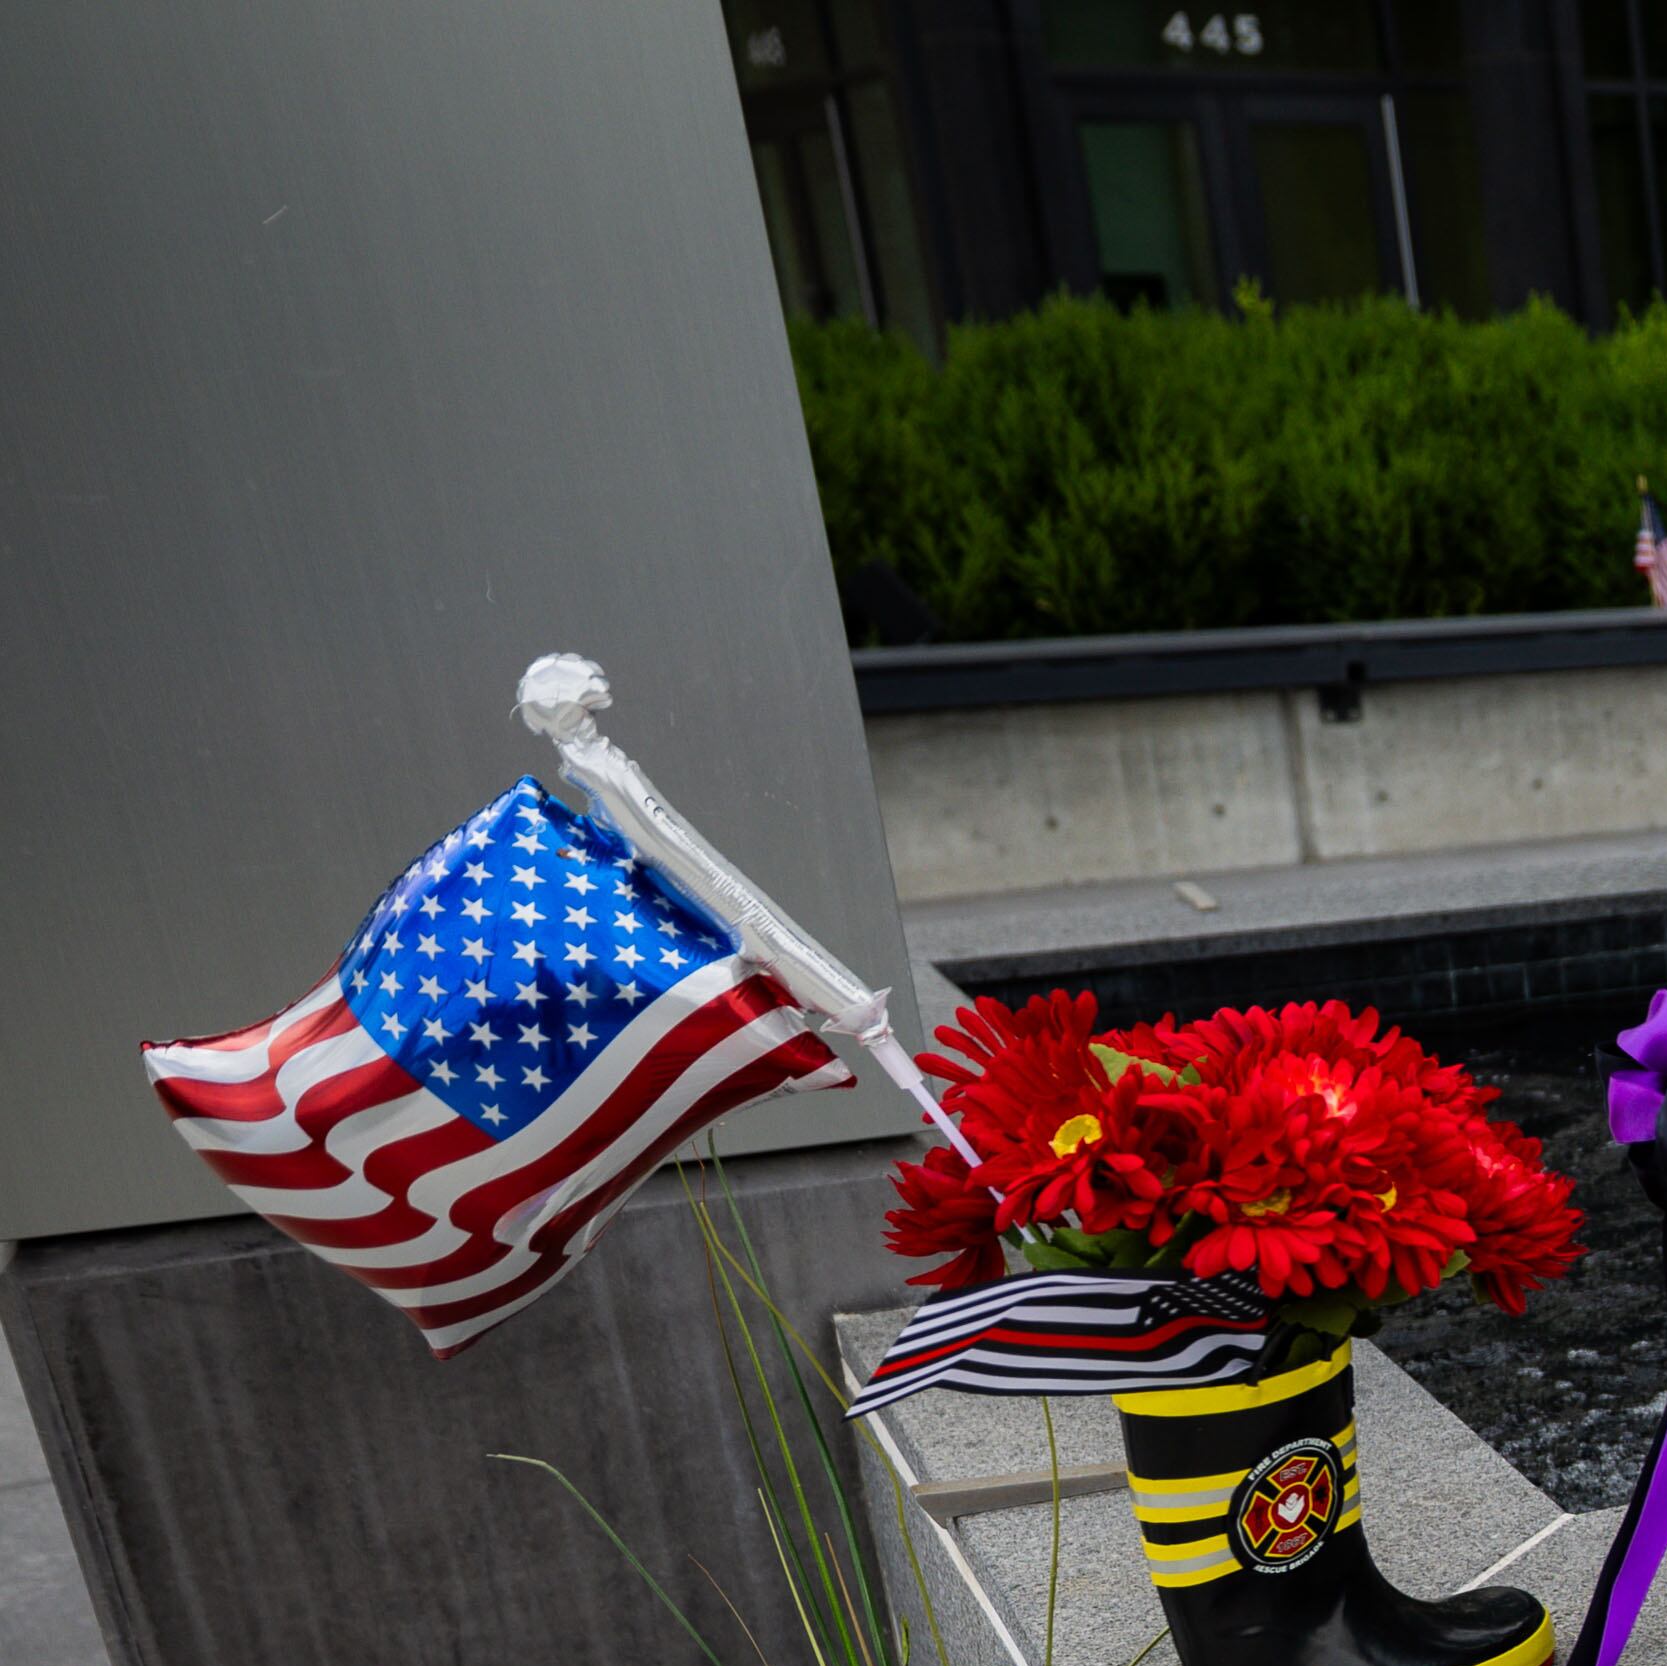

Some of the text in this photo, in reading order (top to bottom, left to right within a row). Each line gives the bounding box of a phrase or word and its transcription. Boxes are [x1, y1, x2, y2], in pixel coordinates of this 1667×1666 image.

[1162, 11, 1264, 55] 445
[1247, 1437, 1333, 1481] FIRE DEPARTMENT
